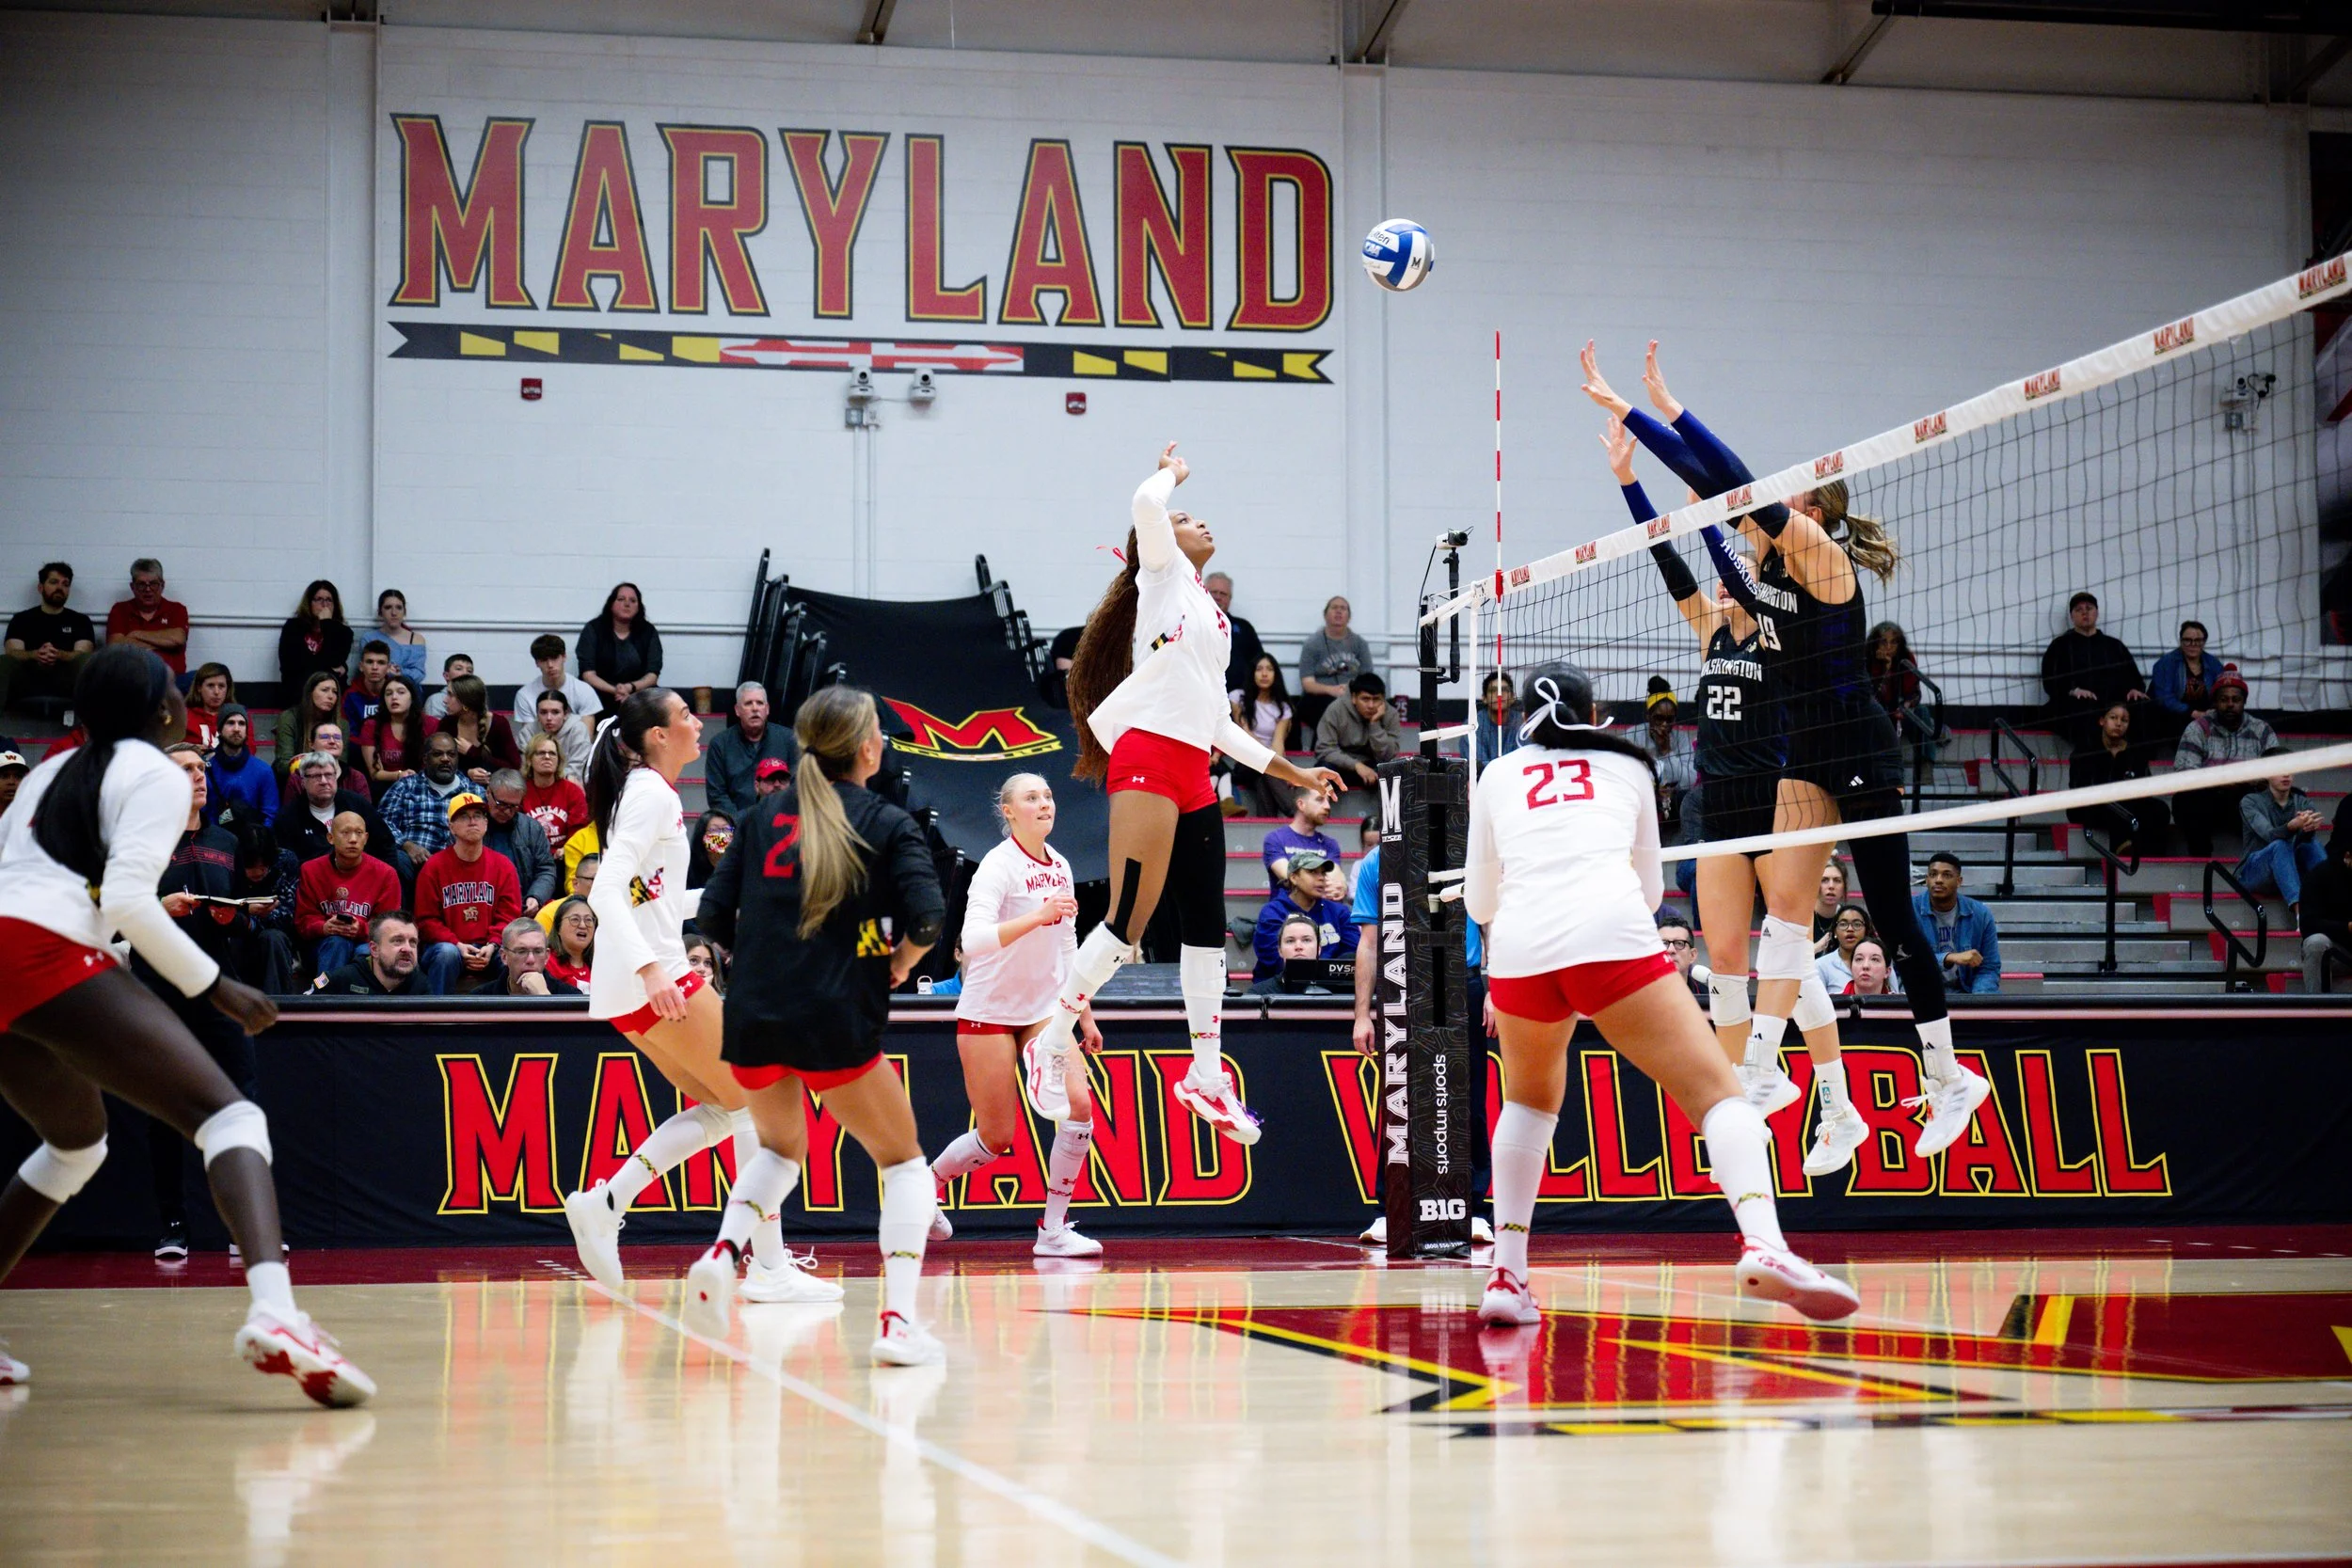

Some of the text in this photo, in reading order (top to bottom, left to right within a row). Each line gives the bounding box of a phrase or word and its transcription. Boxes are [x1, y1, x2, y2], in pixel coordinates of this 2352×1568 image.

[389, 112, 1333, 333] MARYLAND
[1411, 257, 1422, 268] M
[1721, 540, 1758, 596] HUSKIES
[880, 696, 1057, 751] M
[1706, 685, 1742, 721] 22
[463, 795, 474, 804] M
[1522, 759, 1595, 810] 23
[762, 812, 805, 878] 2
[1025, 872, 1069, 894] MARYLAN
[1382, 881, 1409, 1168] MARYLAND
[436, 1045, 2172, 1216] MAYAND VLYBALL
[1434, 1054, 1449, 1175] sports imports
